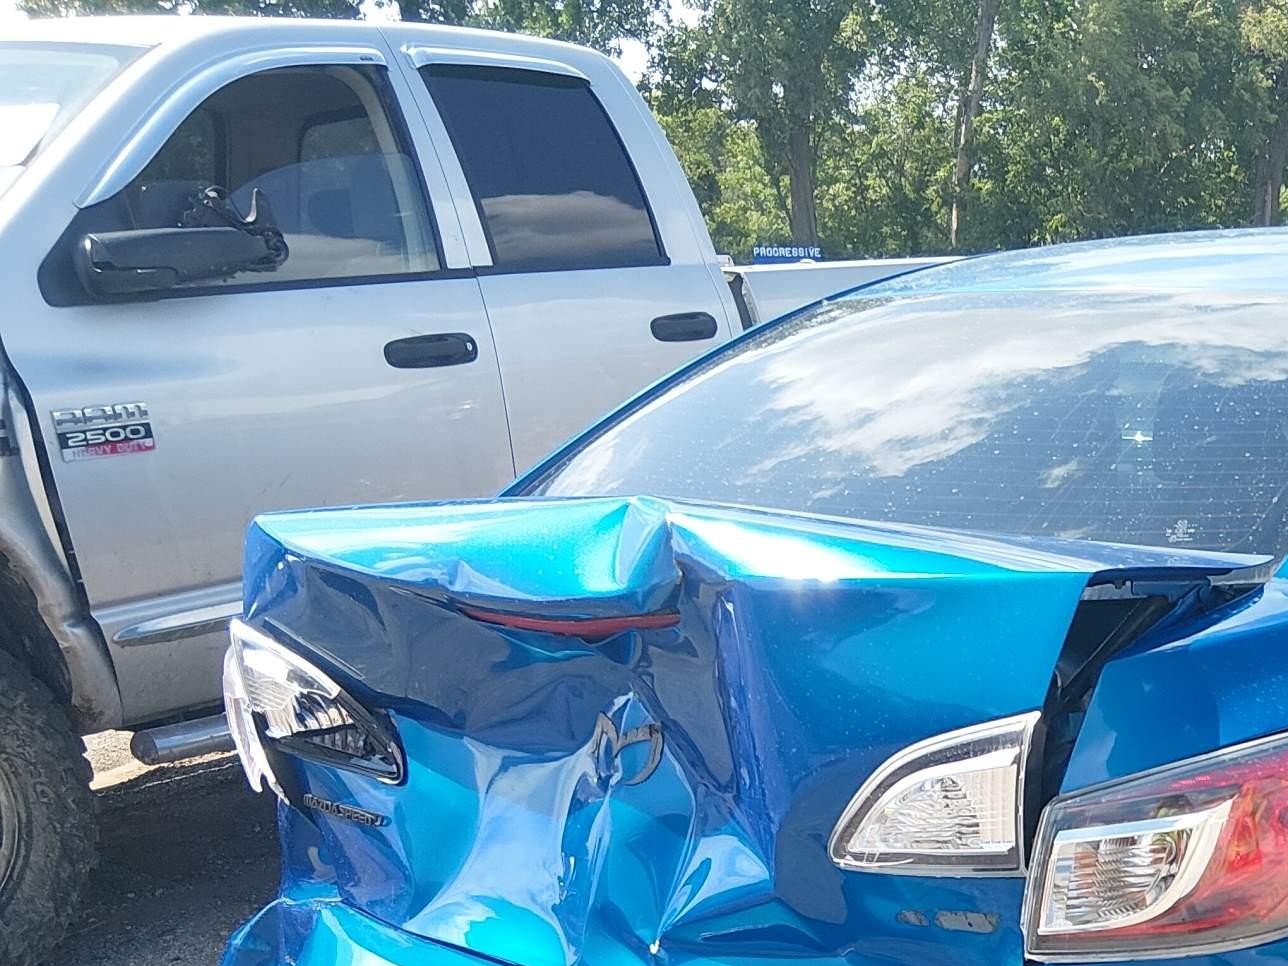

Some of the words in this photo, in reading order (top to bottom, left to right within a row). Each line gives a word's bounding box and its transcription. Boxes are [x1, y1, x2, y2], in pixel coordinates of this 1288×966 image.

[753, 246, 821, 258] PROGRESSIVE
[52, 403, 148, 426] RAM
[65, 425, 147, 448] 2500
[72, 444, 112, 458] HEAVY
